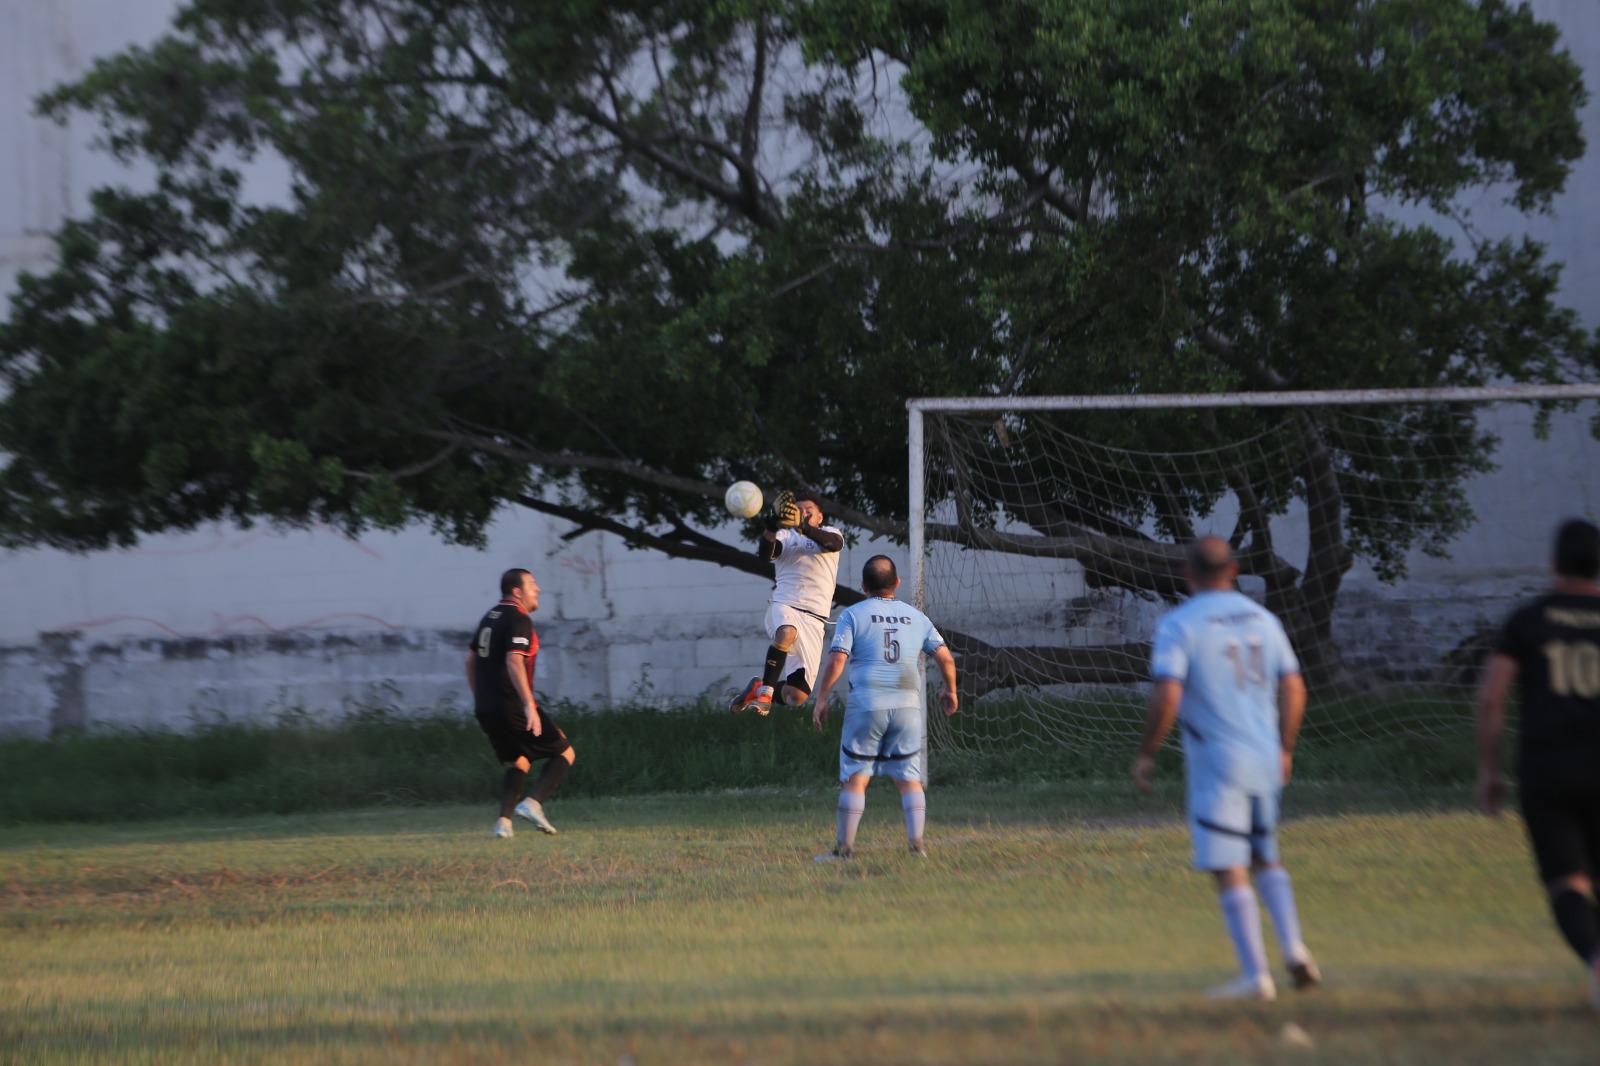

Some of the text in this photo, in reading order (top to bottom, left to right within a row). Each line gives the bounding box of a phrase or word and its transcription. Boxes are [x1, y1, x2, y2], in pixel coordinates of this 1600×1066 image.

[871, 614, 912, 625] DOC
[478, 626, 493, 658] 9
[883, 628, 901, 664] 5
[1543, 641, 1600, 698] 10
